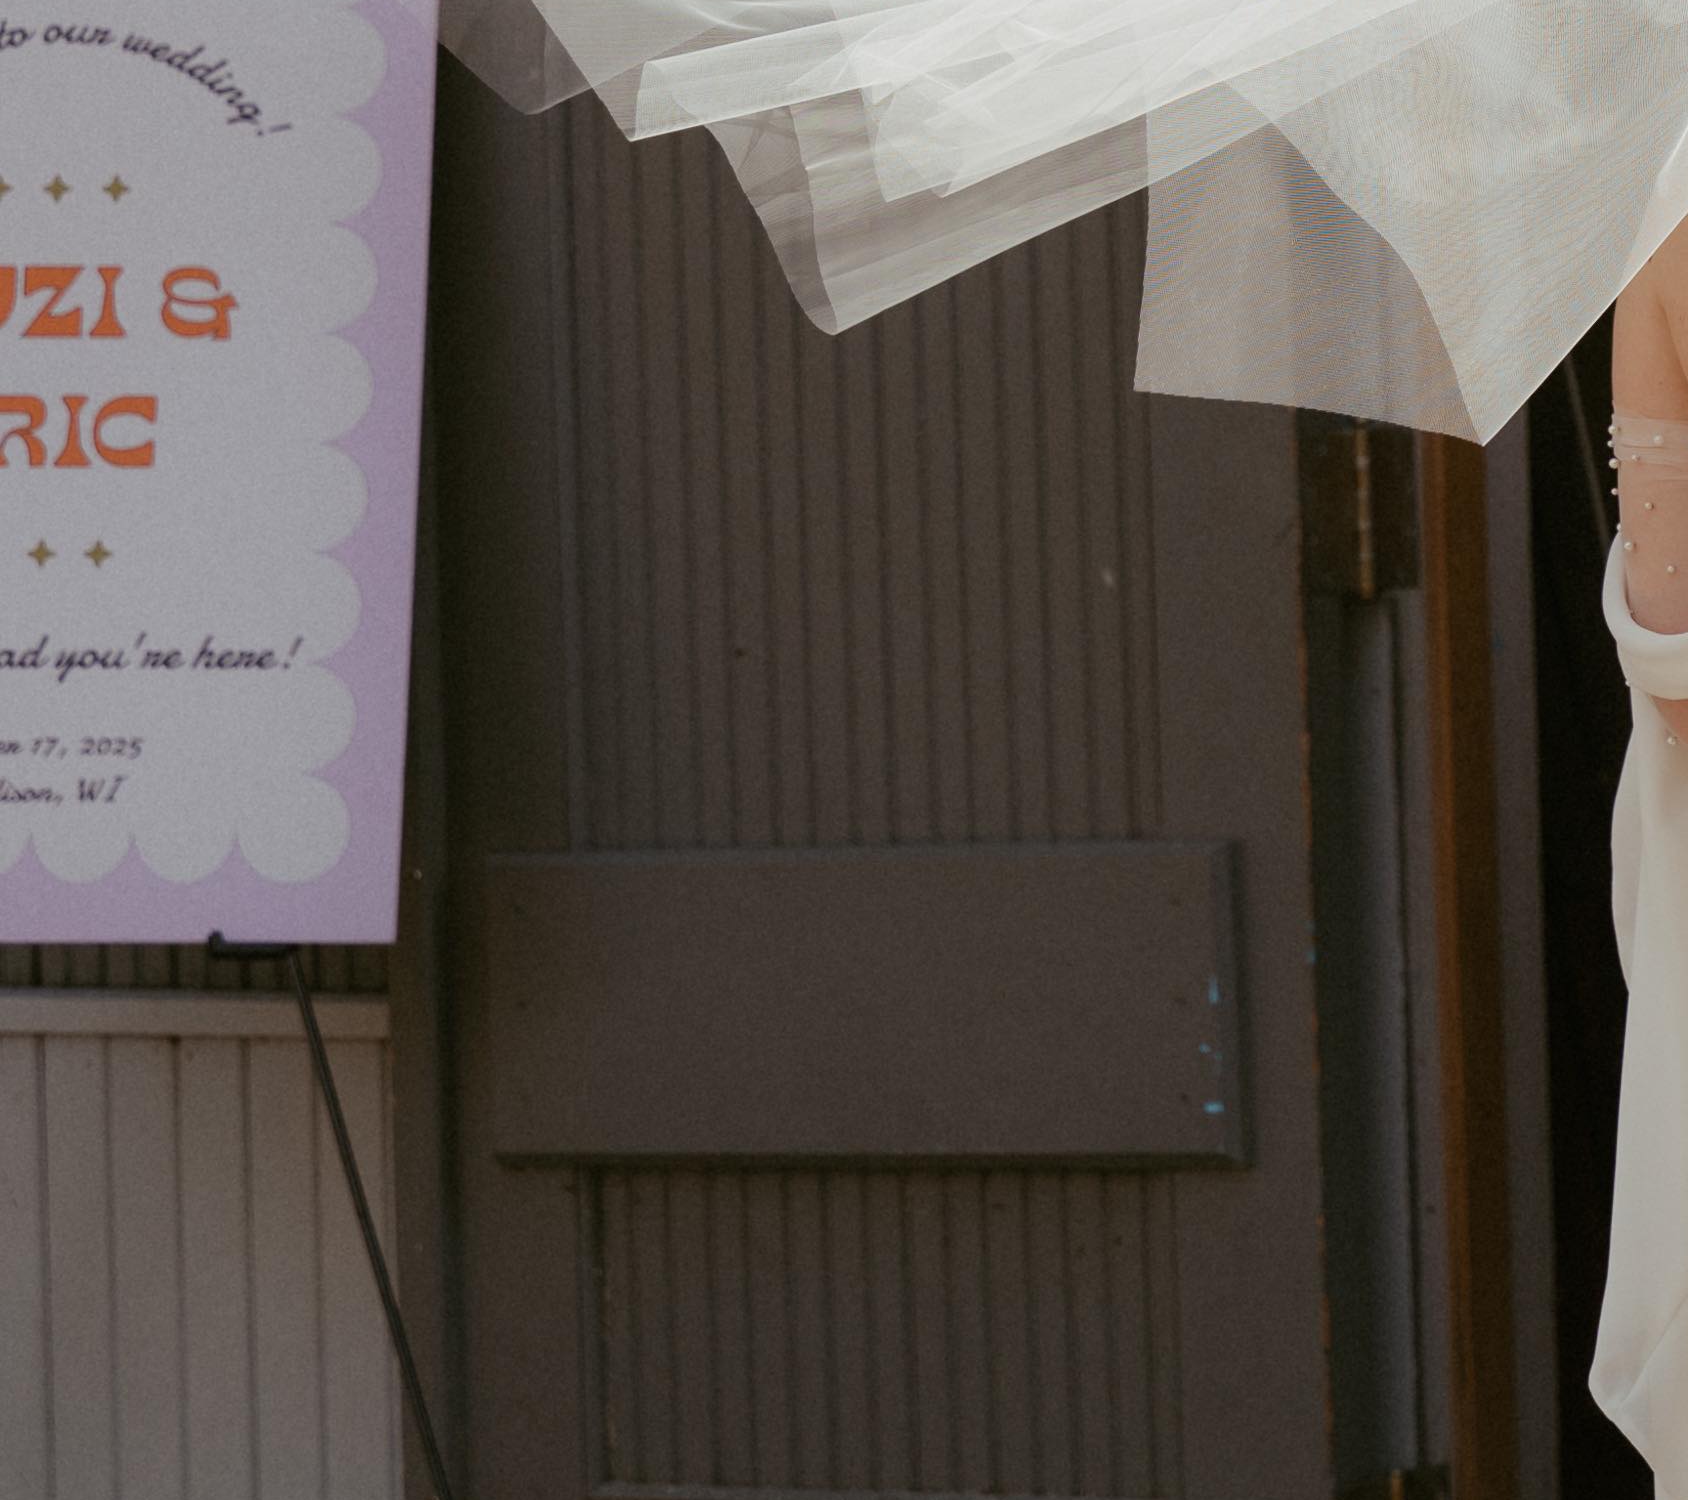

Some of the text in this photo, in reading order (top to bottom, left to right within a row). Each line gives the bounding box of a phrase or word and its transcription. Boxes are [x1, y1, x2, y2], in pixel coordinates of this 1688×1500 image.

[44, 24, 114, 46] our
[122, 32, 292, 137] wedding!
[0, 265, 239, 341] ZI &
[55, 631, 184, 683] you're
[193, 634, 303, 670] here!
[80, 736, 145, 760] 2025
[78, 774, 128, 802] WI
